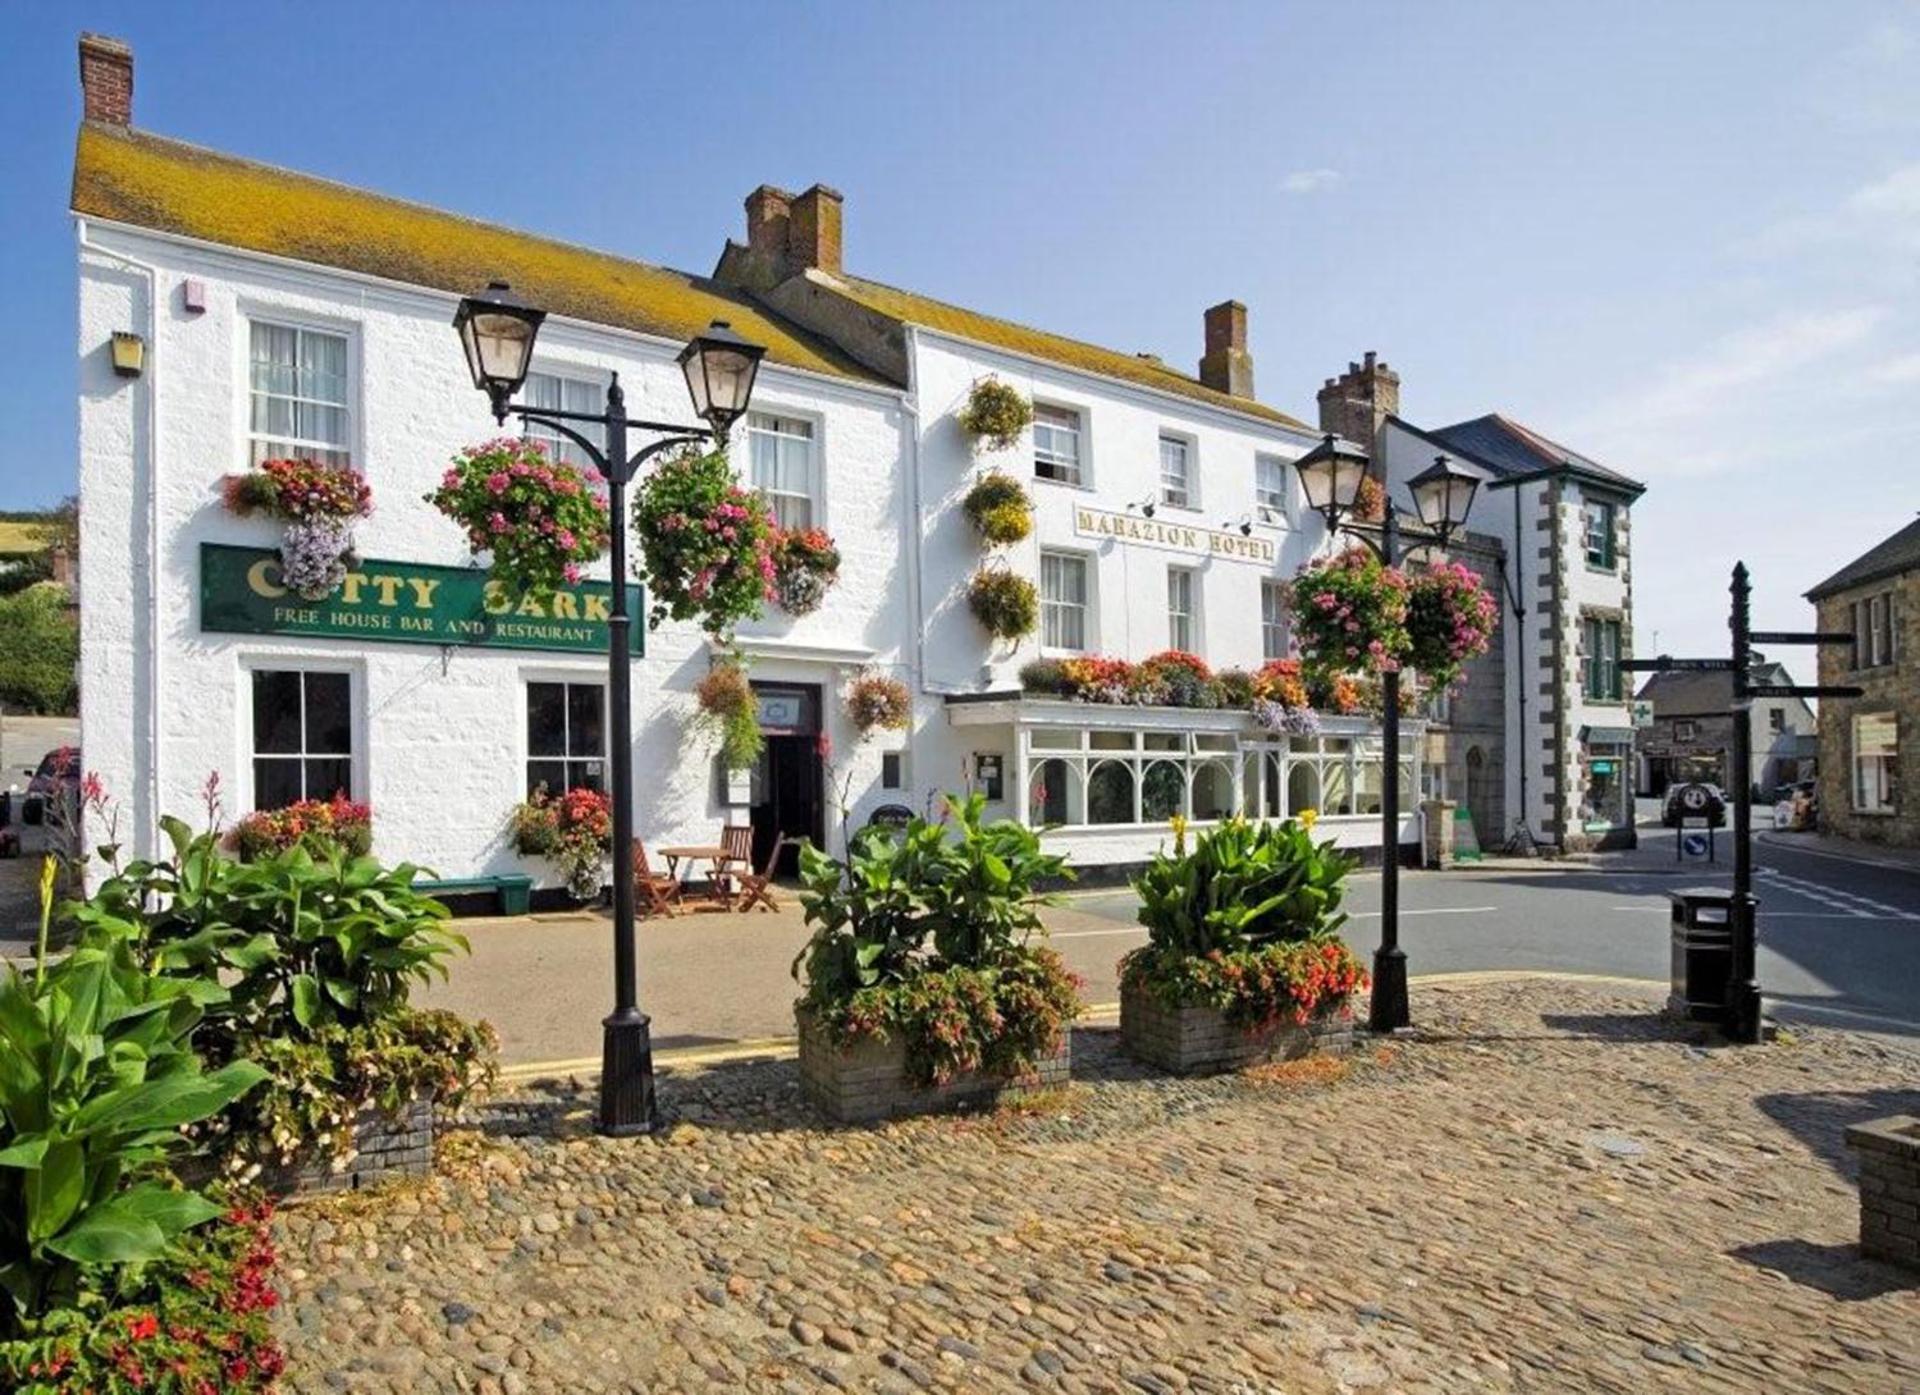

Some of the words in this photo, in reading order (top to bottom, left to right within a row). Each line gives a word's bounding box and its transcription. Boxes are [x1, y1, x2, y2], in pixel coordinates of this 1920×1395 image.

[1079, 510, 1196, 548] MARAZION
[1208, 532, 1274, 562] HOTEL
[246, 558, 441, 609] CTTY
[274, 607, 320, 625] FREE
[330, 612, 392, 630] HOUSE
[401, 616, 434, 632] BAR
[445, 620, 485, 635] AND
[496, 623, 595, 642] RESTAURANT
